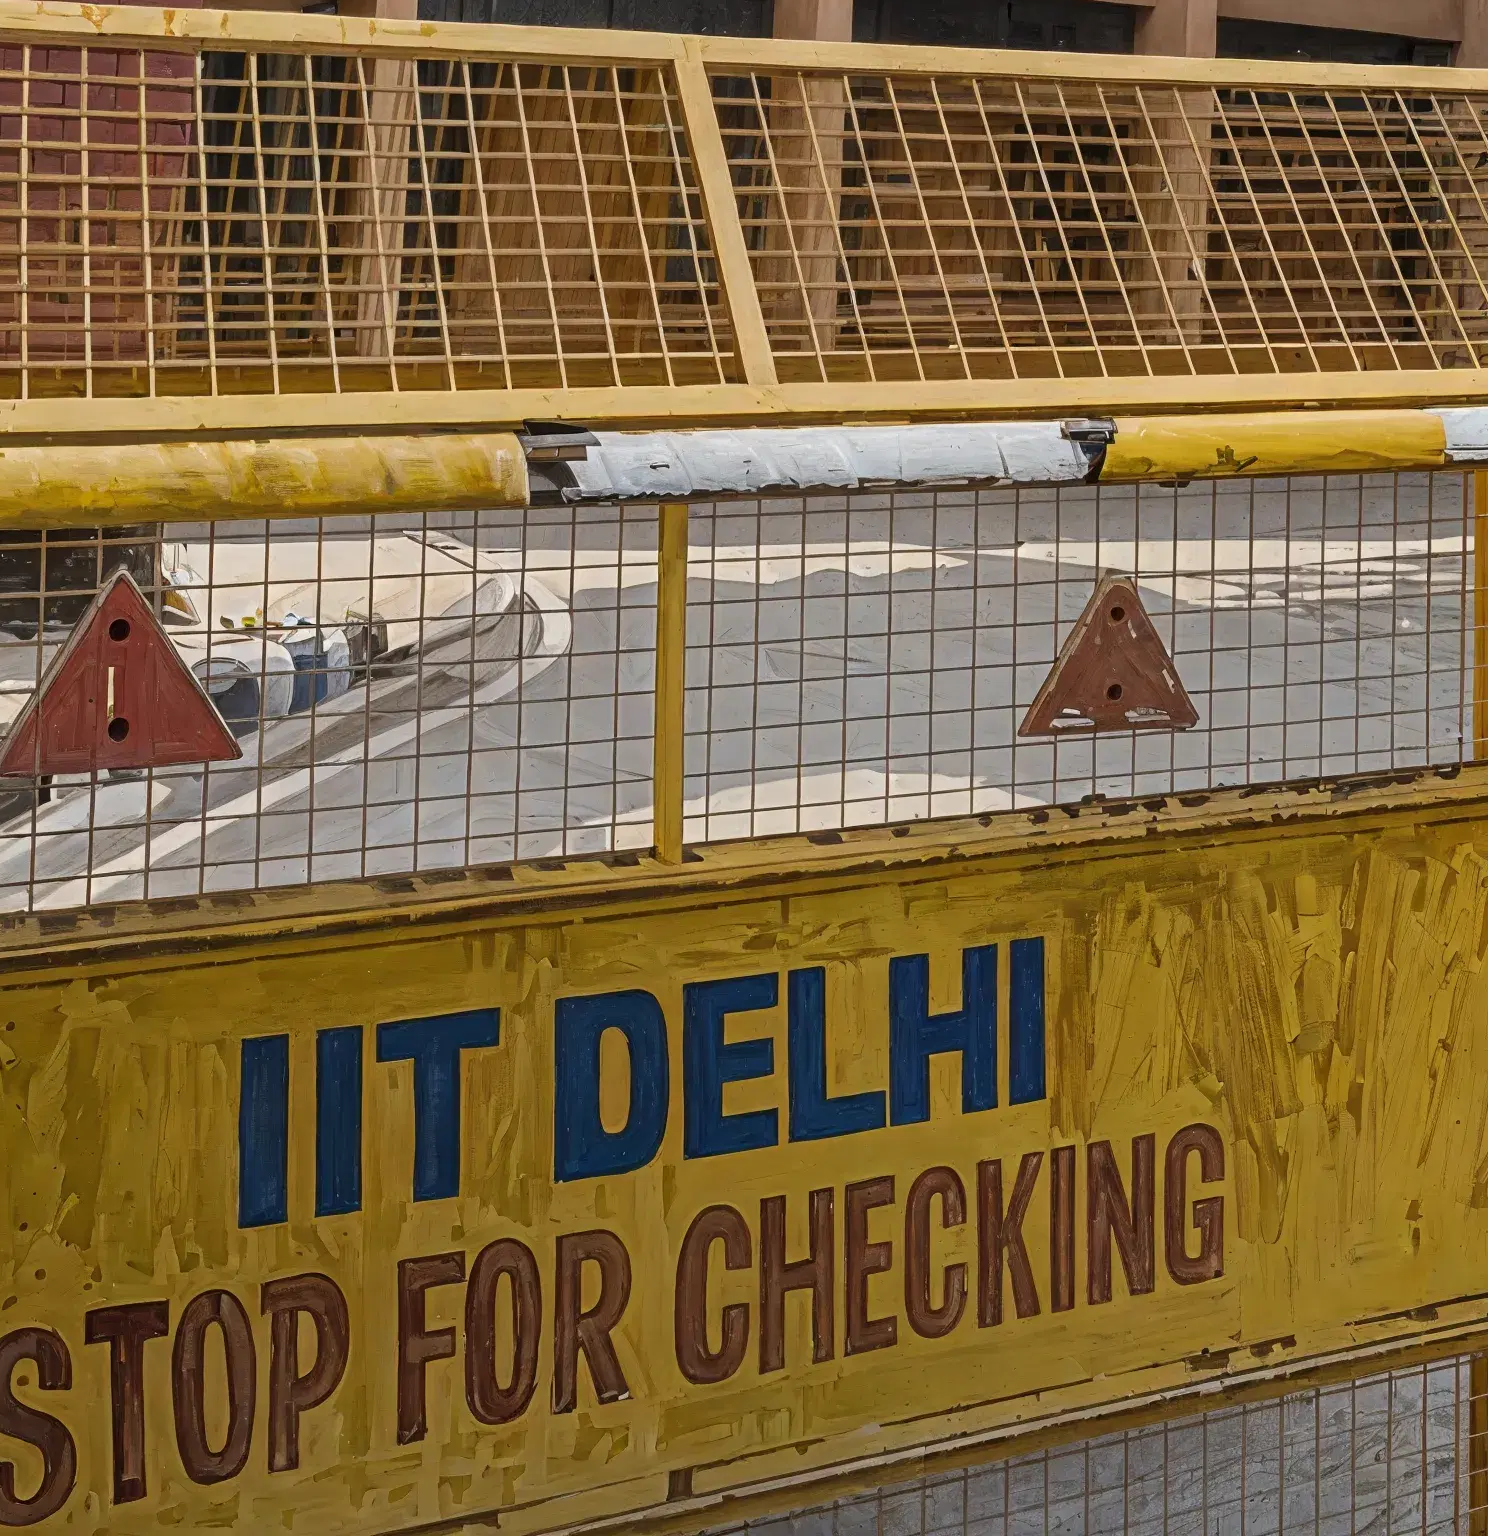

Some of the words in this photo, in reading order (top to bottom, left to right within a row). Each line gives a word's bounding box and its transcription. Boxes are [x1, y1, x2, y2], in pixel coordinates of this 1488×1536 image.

[238, 1007, 501, 1228] IIT
[554, 936, 1046, 1184] DELHI
[396, 1230, 632, 1446] FOR
[673, 1122, 1225, 1385] CHECKING
